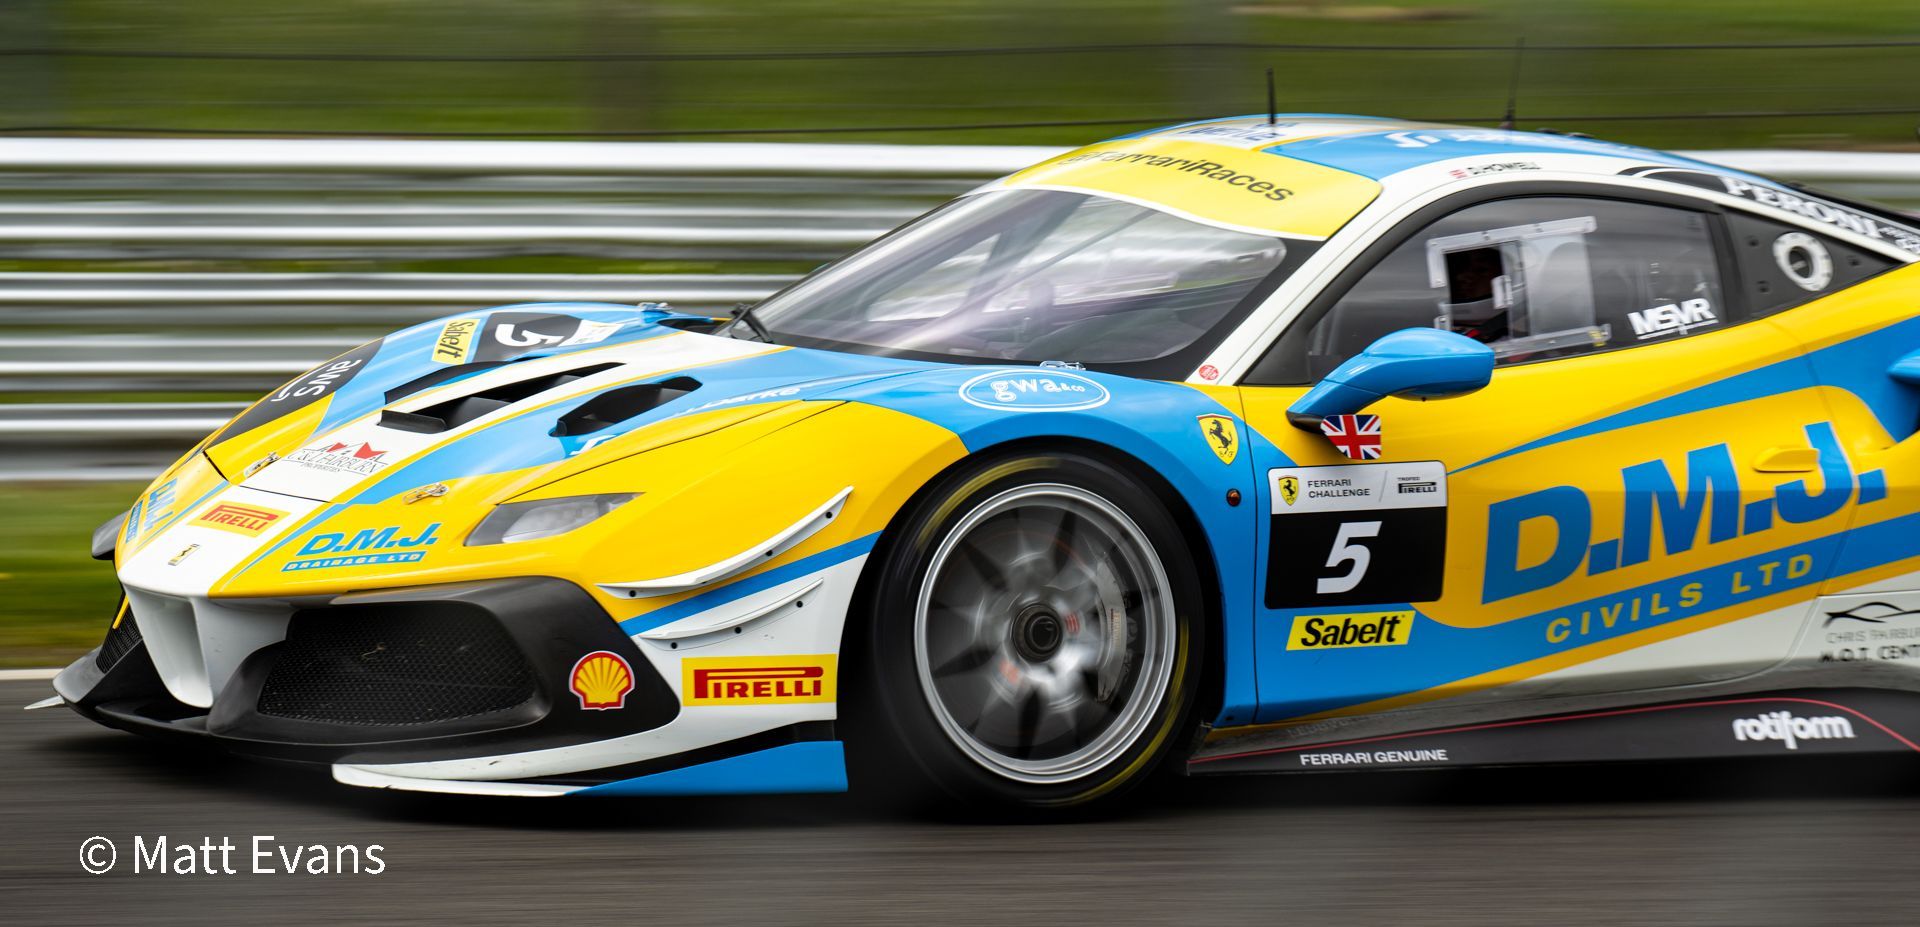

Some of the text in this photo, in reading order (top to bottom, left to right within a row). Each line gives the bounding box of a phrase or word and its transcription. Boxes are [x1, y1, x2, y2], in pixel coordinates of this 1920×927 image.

[1718, 174, 1883, 239] PERONI
[1628, 298, 1717, 336] MSVR
[437, 321, 475, 359] Sabelt
[495, 323, 565, 347] 5
[292, 359, 363, 397] aws
[1307, 478, 1352, 489] FERRARI
[1308, 488, 1371, 499] CHALLENGE
[1397, 481, 1437, 494] PIRELLI
[200, 504, 279, 531] PIRELLI
[1481, 421, 1888, 606] D.M.J.
[296, 522, 443, 557] D.M.J.
[286, 552, 421, 571] DRAINAGE LTD
[1316, 521, 1382, 594] 5
[1545, 553, 1814, 644] CIVILS LTD
[1300, 614, 1402, 647] Sabelt
[694, 666, 824, 699] PIRELLI
[1732, 710, 1857, 750] rotiform
[1300, 749, 1449, 766] FERRARI GENUINE
